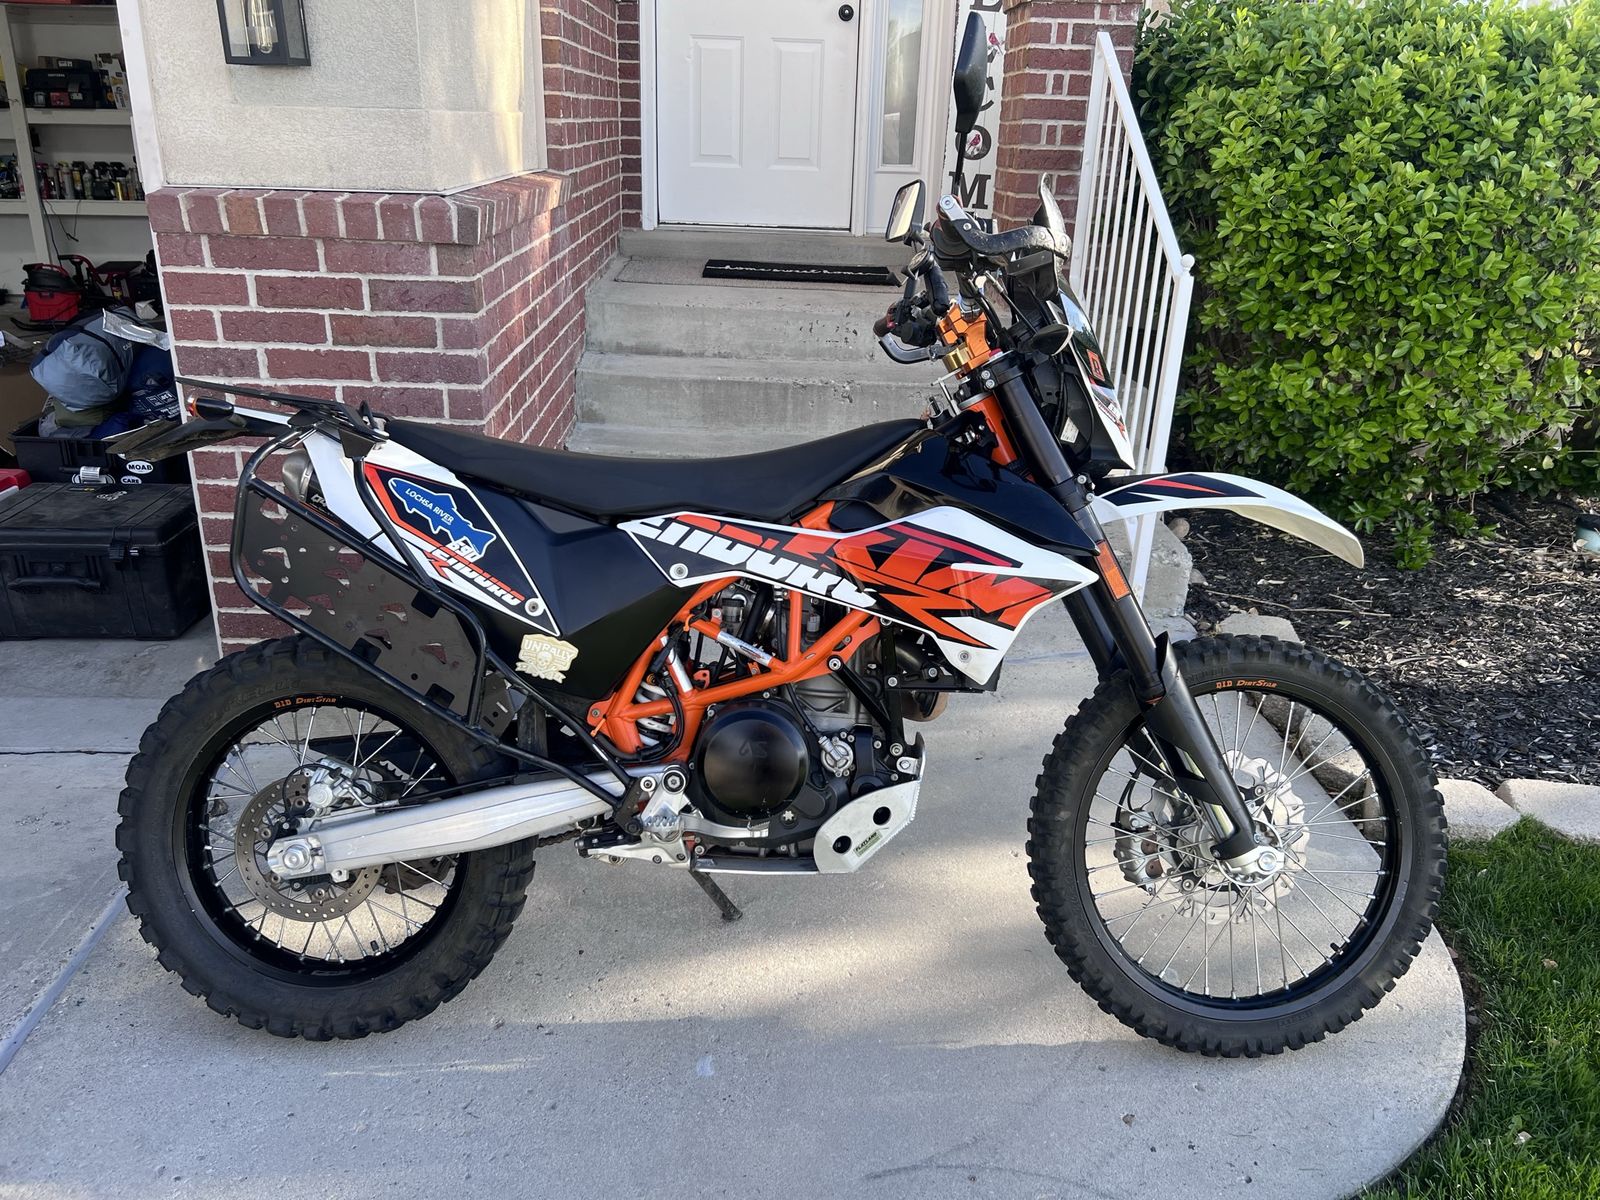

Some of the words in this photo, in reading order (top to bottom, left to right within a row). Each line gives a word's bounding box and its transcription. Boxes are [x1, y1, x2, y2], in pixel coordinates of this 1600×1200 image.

[128, 463, 153, 471] MOAB
[405, 487, 434, 510] LOCHSA
[432, 506, 455, 524] RIVER
